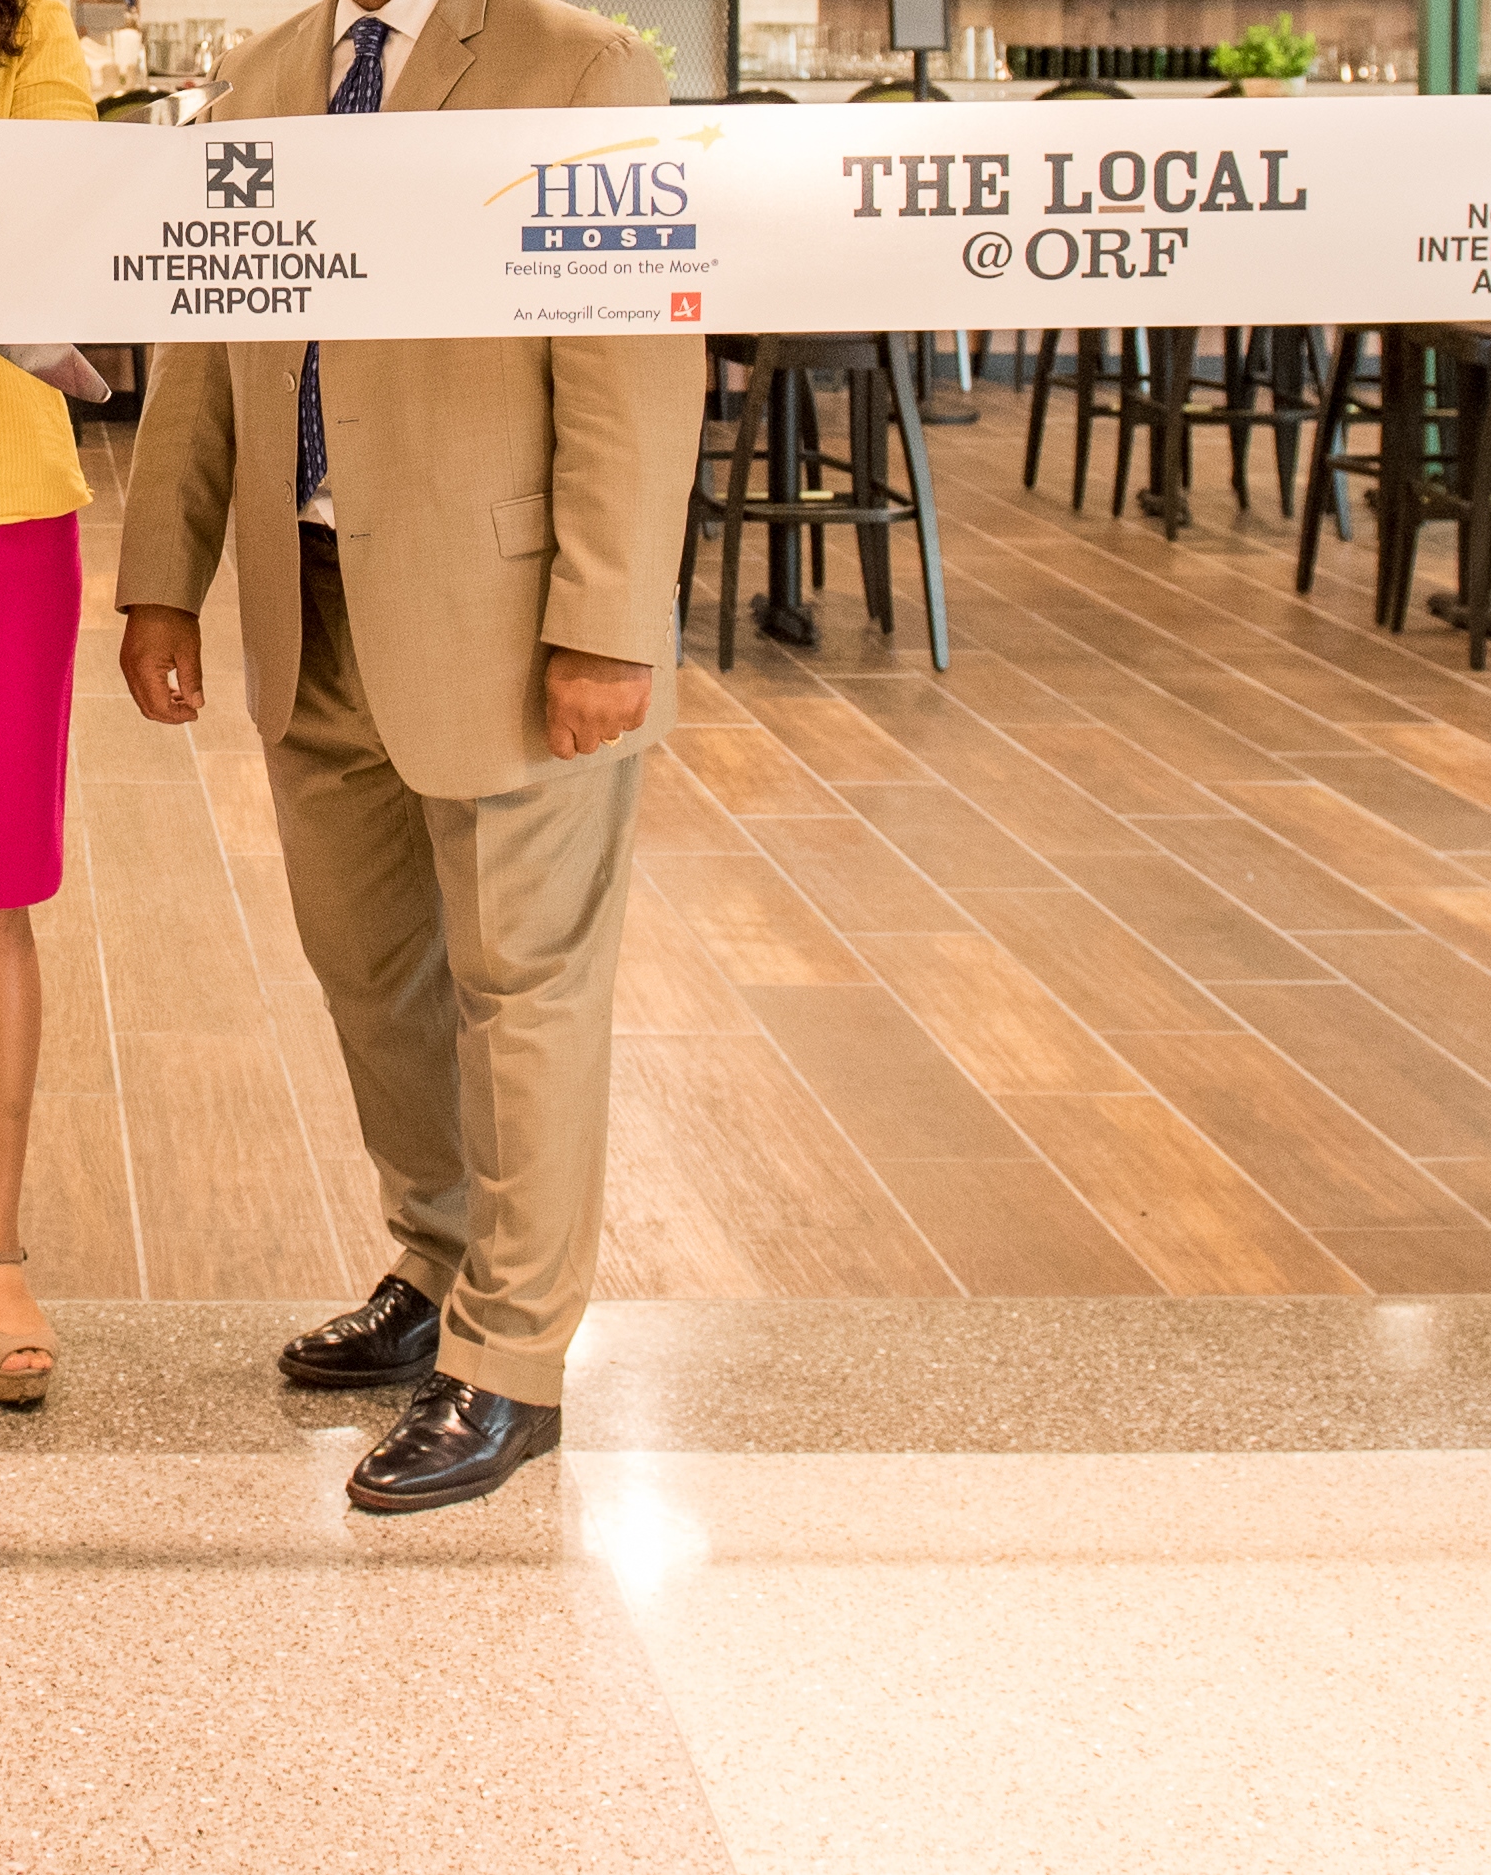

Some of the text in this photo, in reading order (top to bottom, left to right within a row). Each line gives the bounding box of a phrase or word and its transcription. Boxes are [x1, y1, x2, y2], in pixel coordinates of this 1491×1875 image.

[531, 162, 687, 218] HMS
[844, 150, 1306, 217] THE LOCAL
[163, 221, 316, 247] NORFOLK
[545, 228, 672, 248] HOST
[114, 253, 367, 281] INTERNATIONAL
[506, 262, 561, 278] Feeling
[567, 261, 607, 274] Good
[614, 264, 631, 274] on
[639, 260, 664, 273] the
[171, 287, 311, 314] AIRPORT
[514, 306, 660, 323] An Autogrill Company
